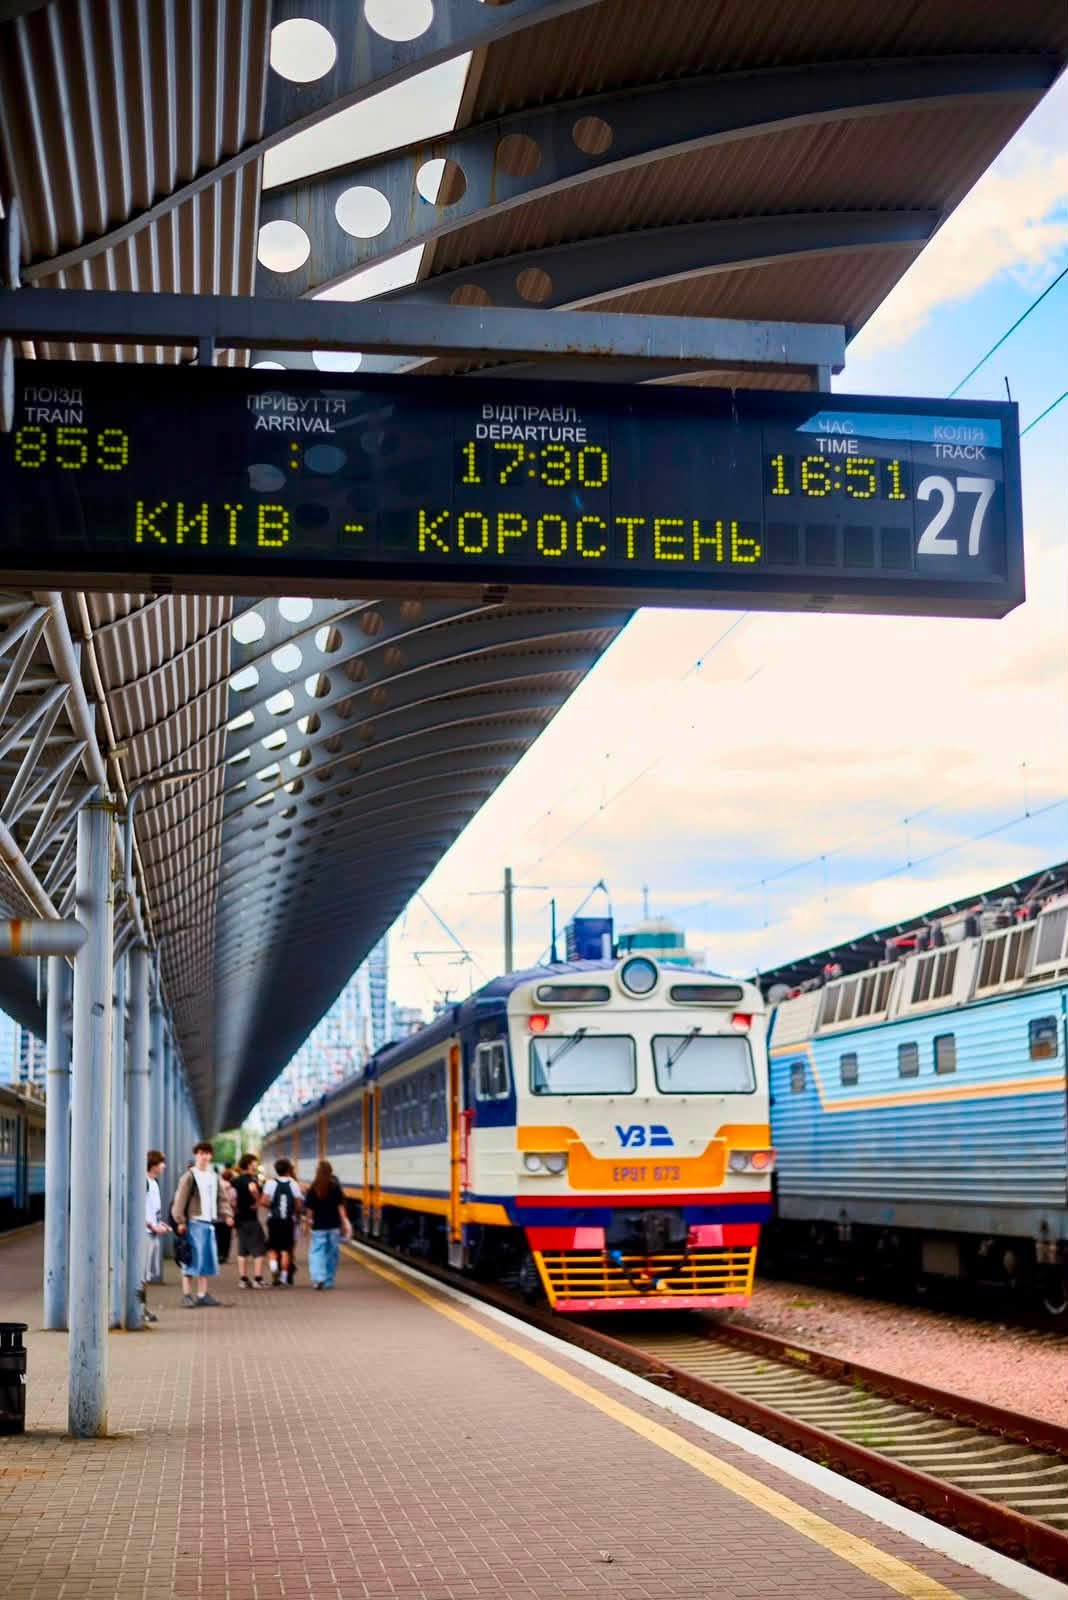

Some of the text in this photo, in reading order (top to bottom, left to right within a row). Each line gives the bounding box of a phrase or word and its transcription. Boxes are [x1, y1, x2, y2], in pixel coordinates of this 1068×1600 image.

[246, 394, 347, 414] ПРИБУТТЯ
[481, 404, 583, 424] ВІДПРАВЛ.
[23, 406, 84, 424] TRAIN
[255, 415, 336, 433] ARRIVAL
[475, 424, 588, 443] DEPARTURE
[818, 420, 855, 435] ЧАС
[15, 426, 130, 471] 859
[815, 438, 860, 455] TIME
[932, 444, 986, 460] TRACK
[462, 441, 609, 487] 17:30
[771, 454, 906, 500] 16:51
[916, 475, 995, 556] 27
[135, 500, 290, 547] КИЇВ
[418, 509, 762, 565] КОРОСТЕНЬ
